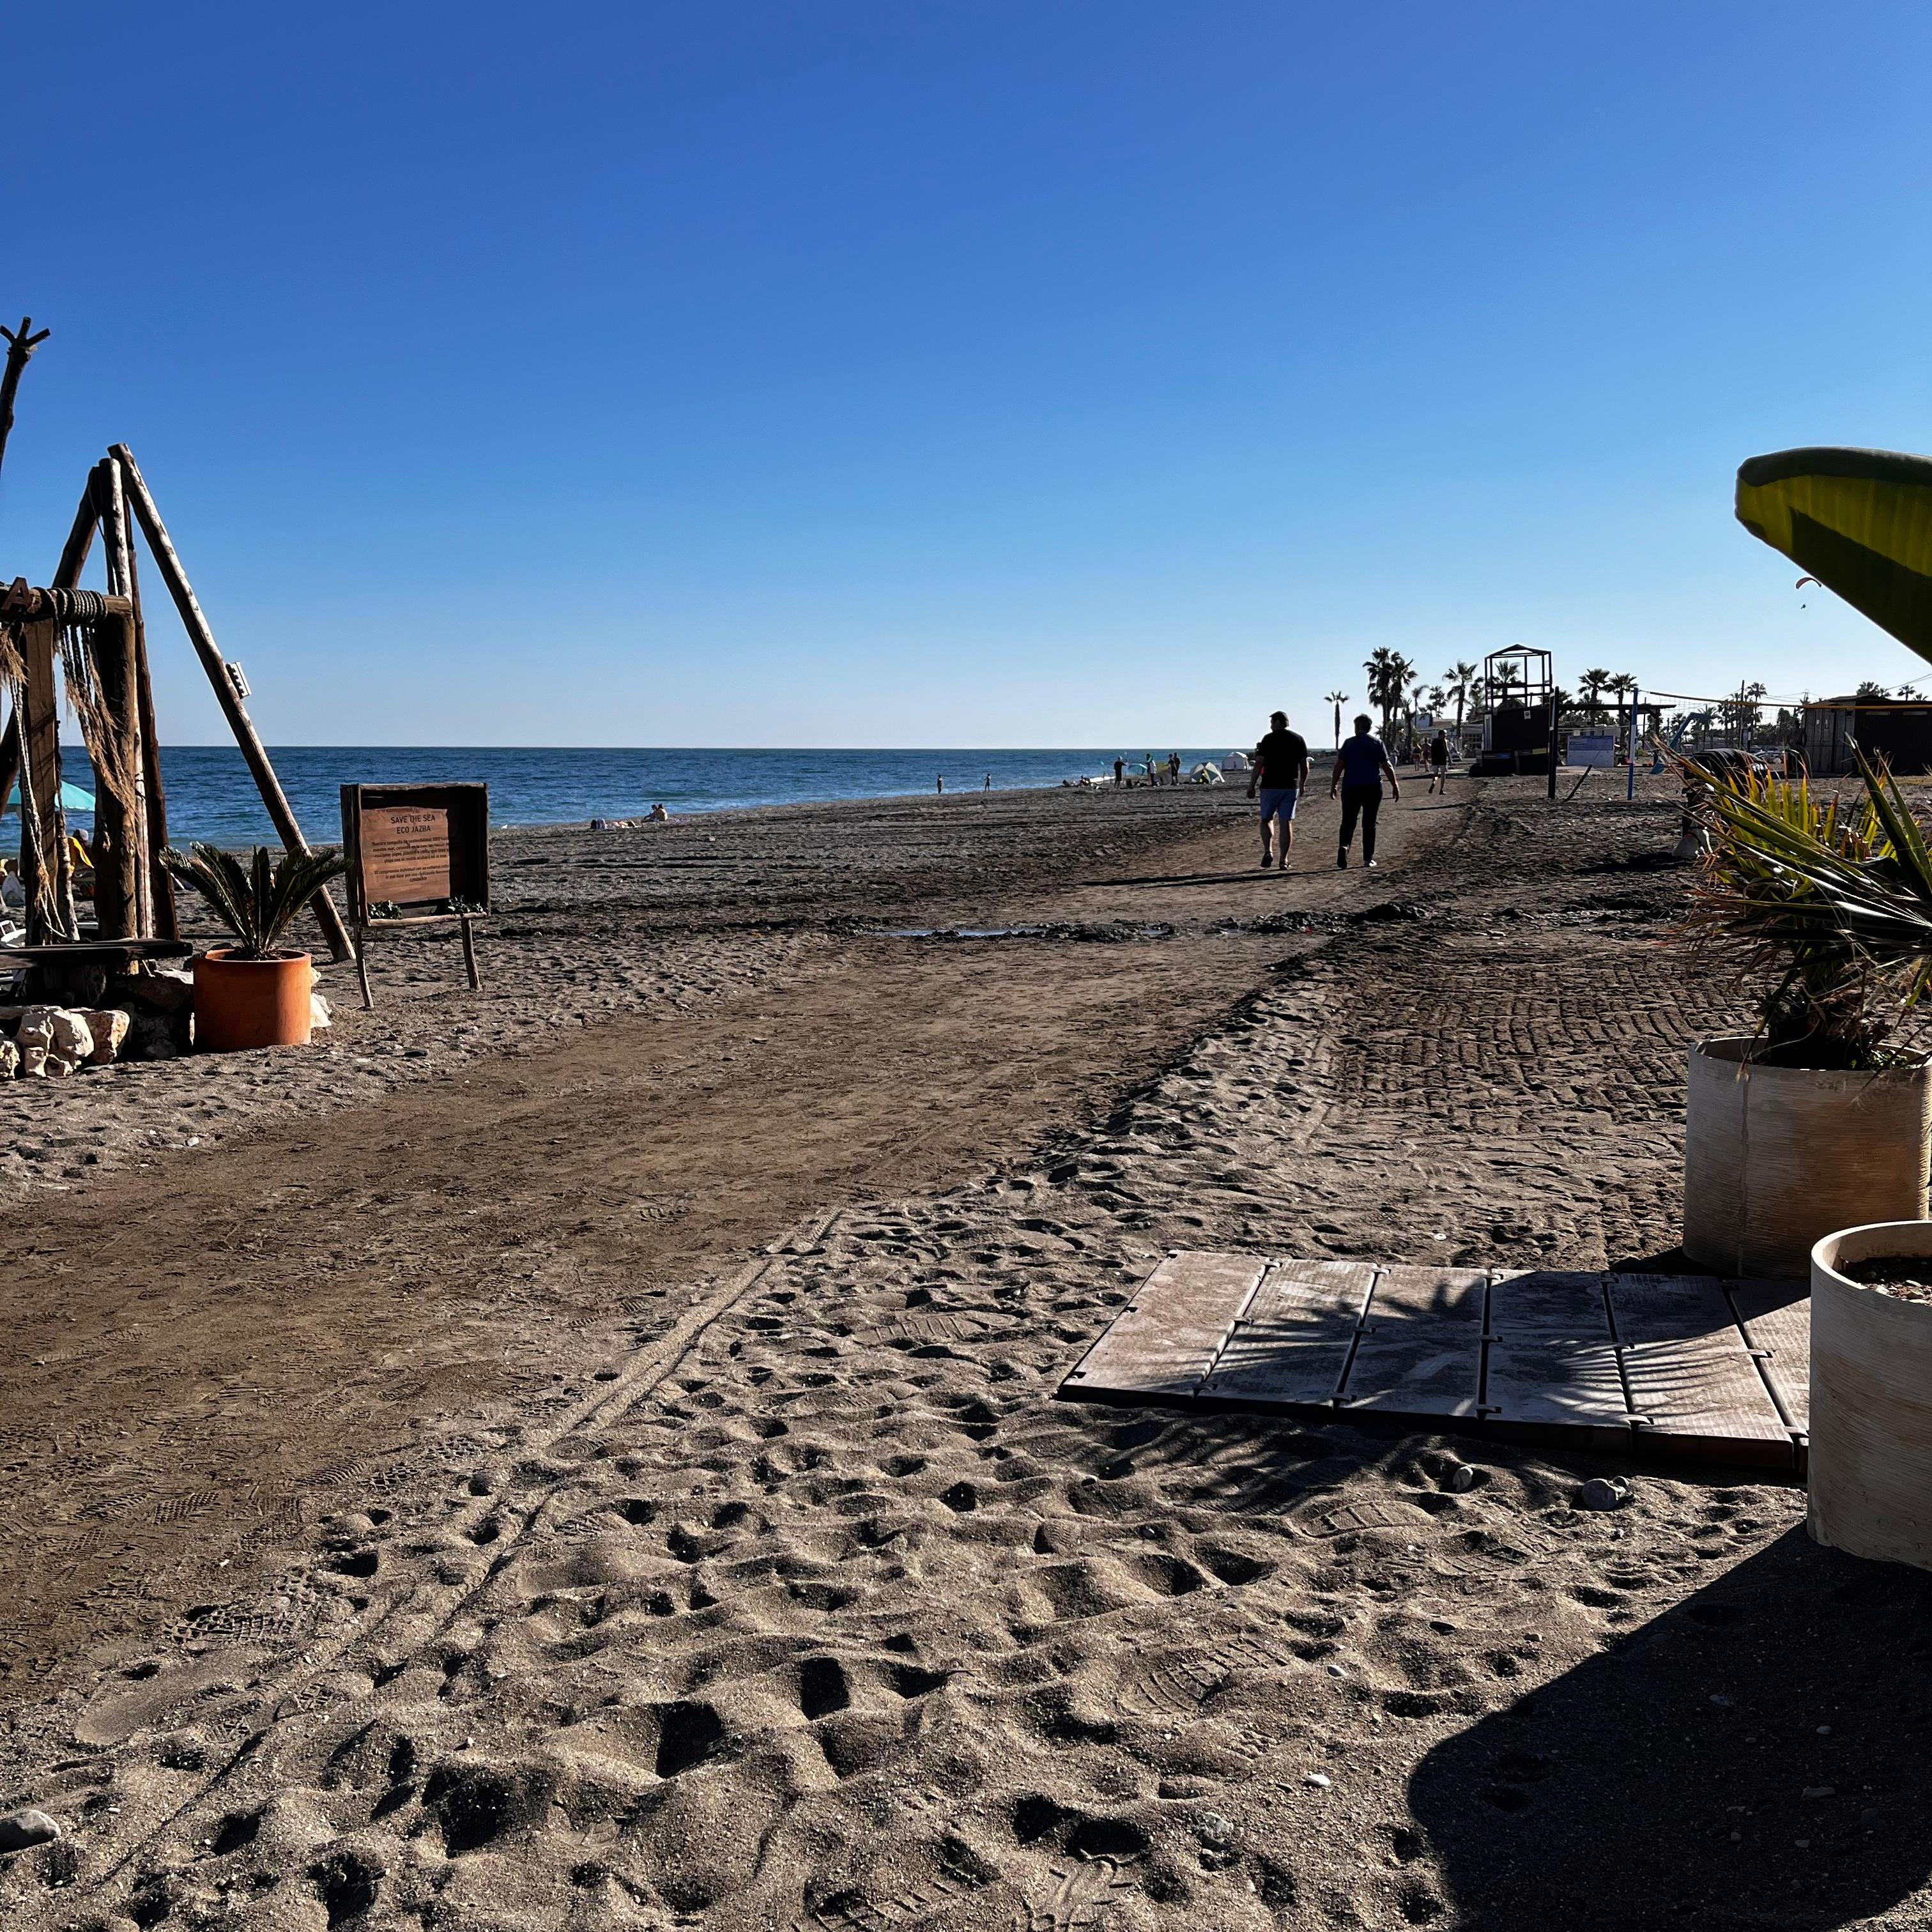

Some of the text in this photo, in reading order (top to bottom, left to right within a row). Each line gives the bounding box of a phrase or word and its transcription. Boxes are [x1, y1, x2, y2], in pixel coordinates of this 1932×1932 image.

[390, 813, 435, 824] SAVE THE SEA
[411, 825, 431, 833] JAZBA
